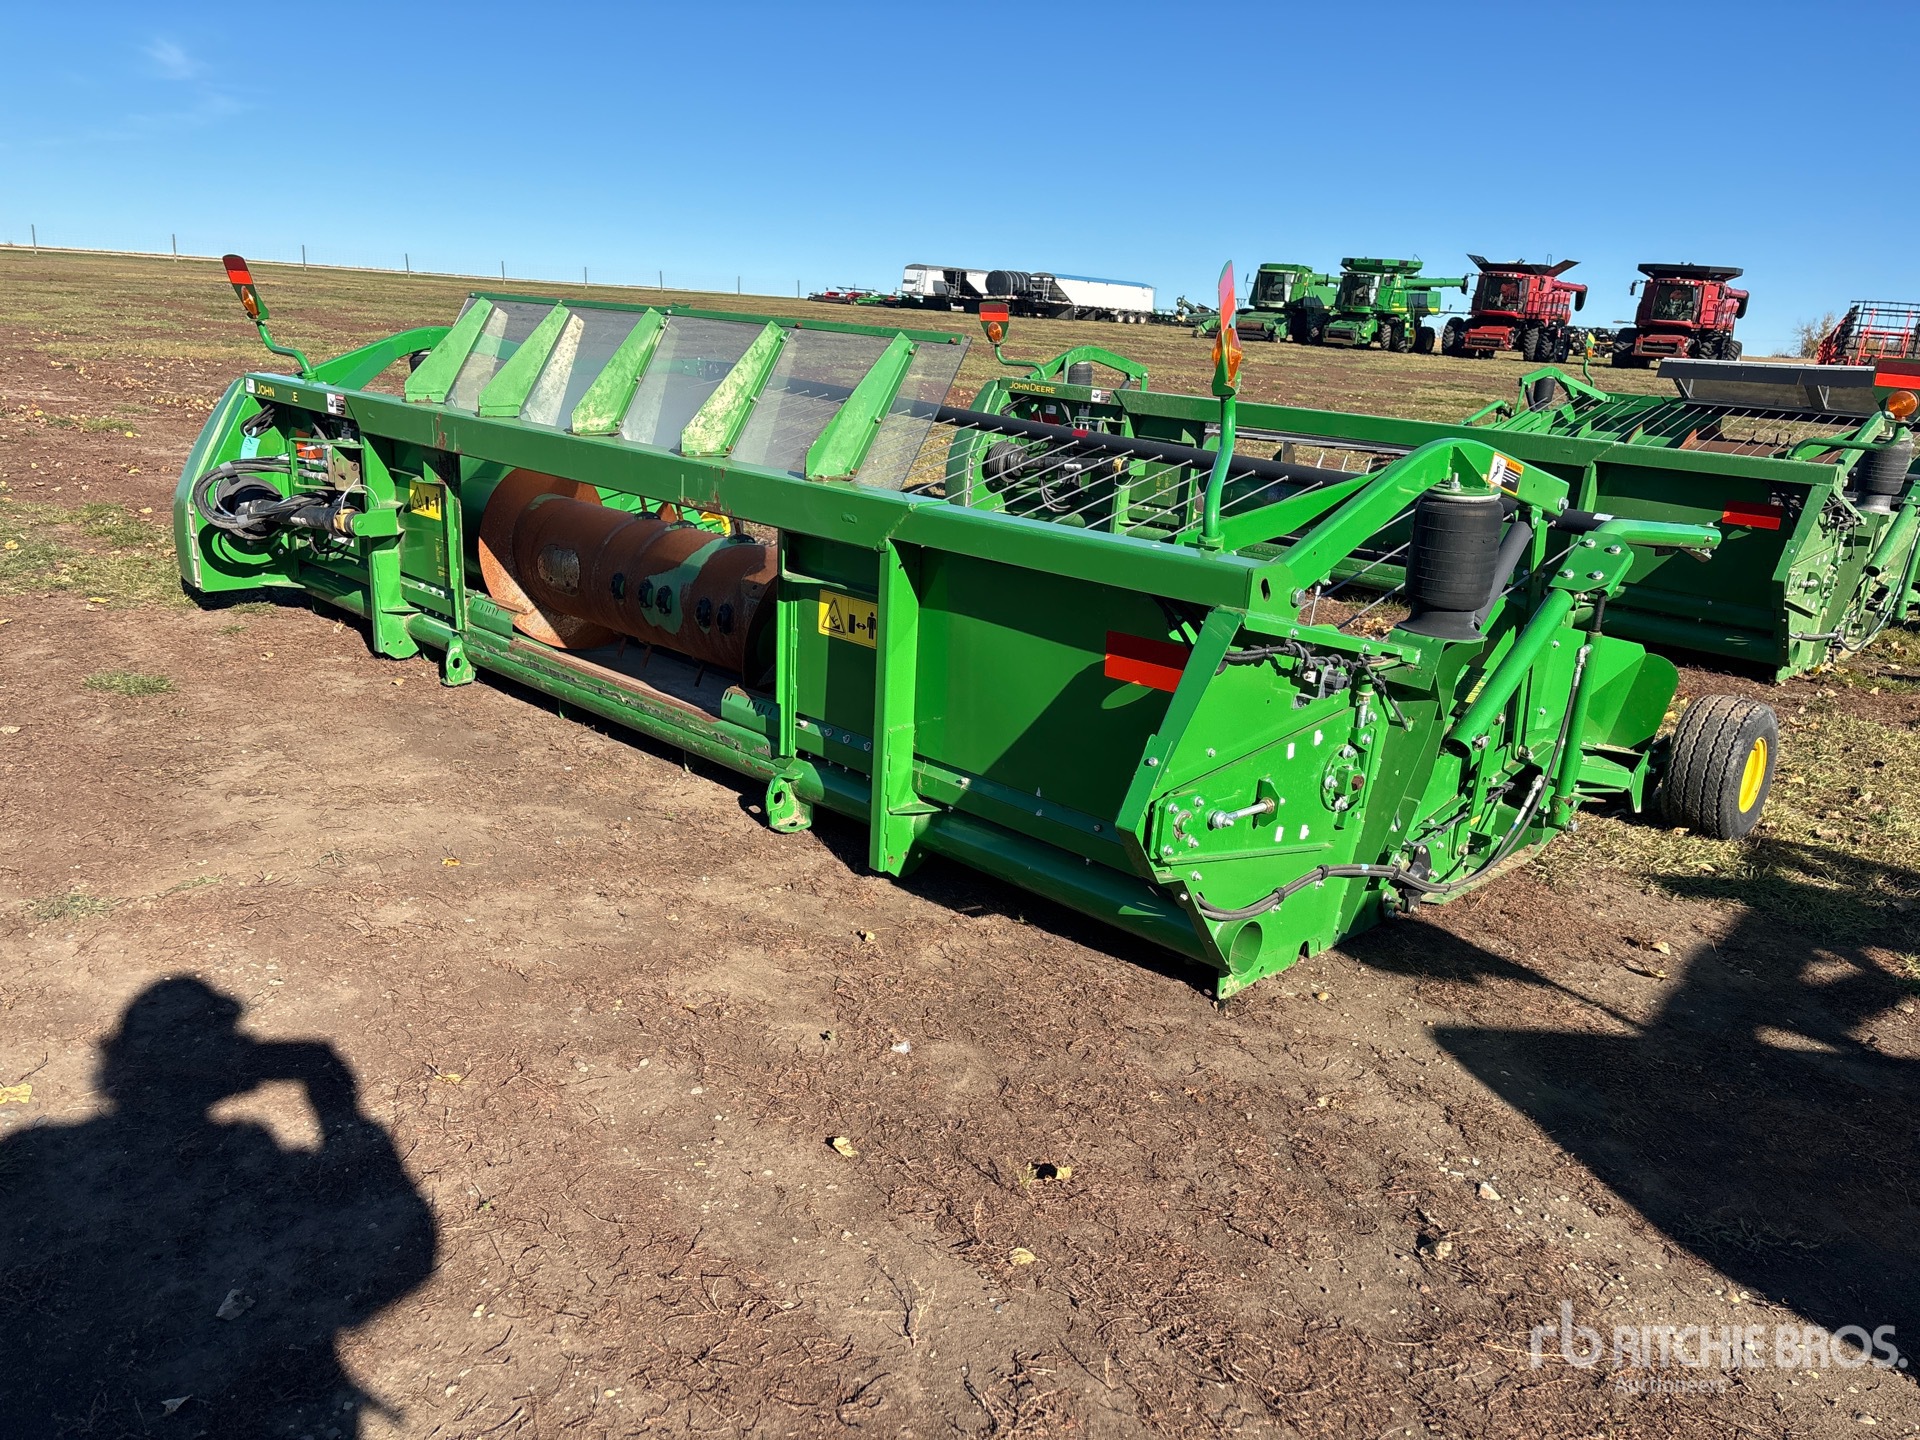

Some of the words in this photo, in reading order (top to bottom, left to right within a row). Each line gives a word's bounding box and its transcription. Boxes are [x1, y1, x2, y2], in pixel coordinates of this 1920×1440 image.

[257, 383, 275, 398] JOHN
[1009, 382, 1030, 391] JOHN
[1030, 383, 1057, 394] DEERE
